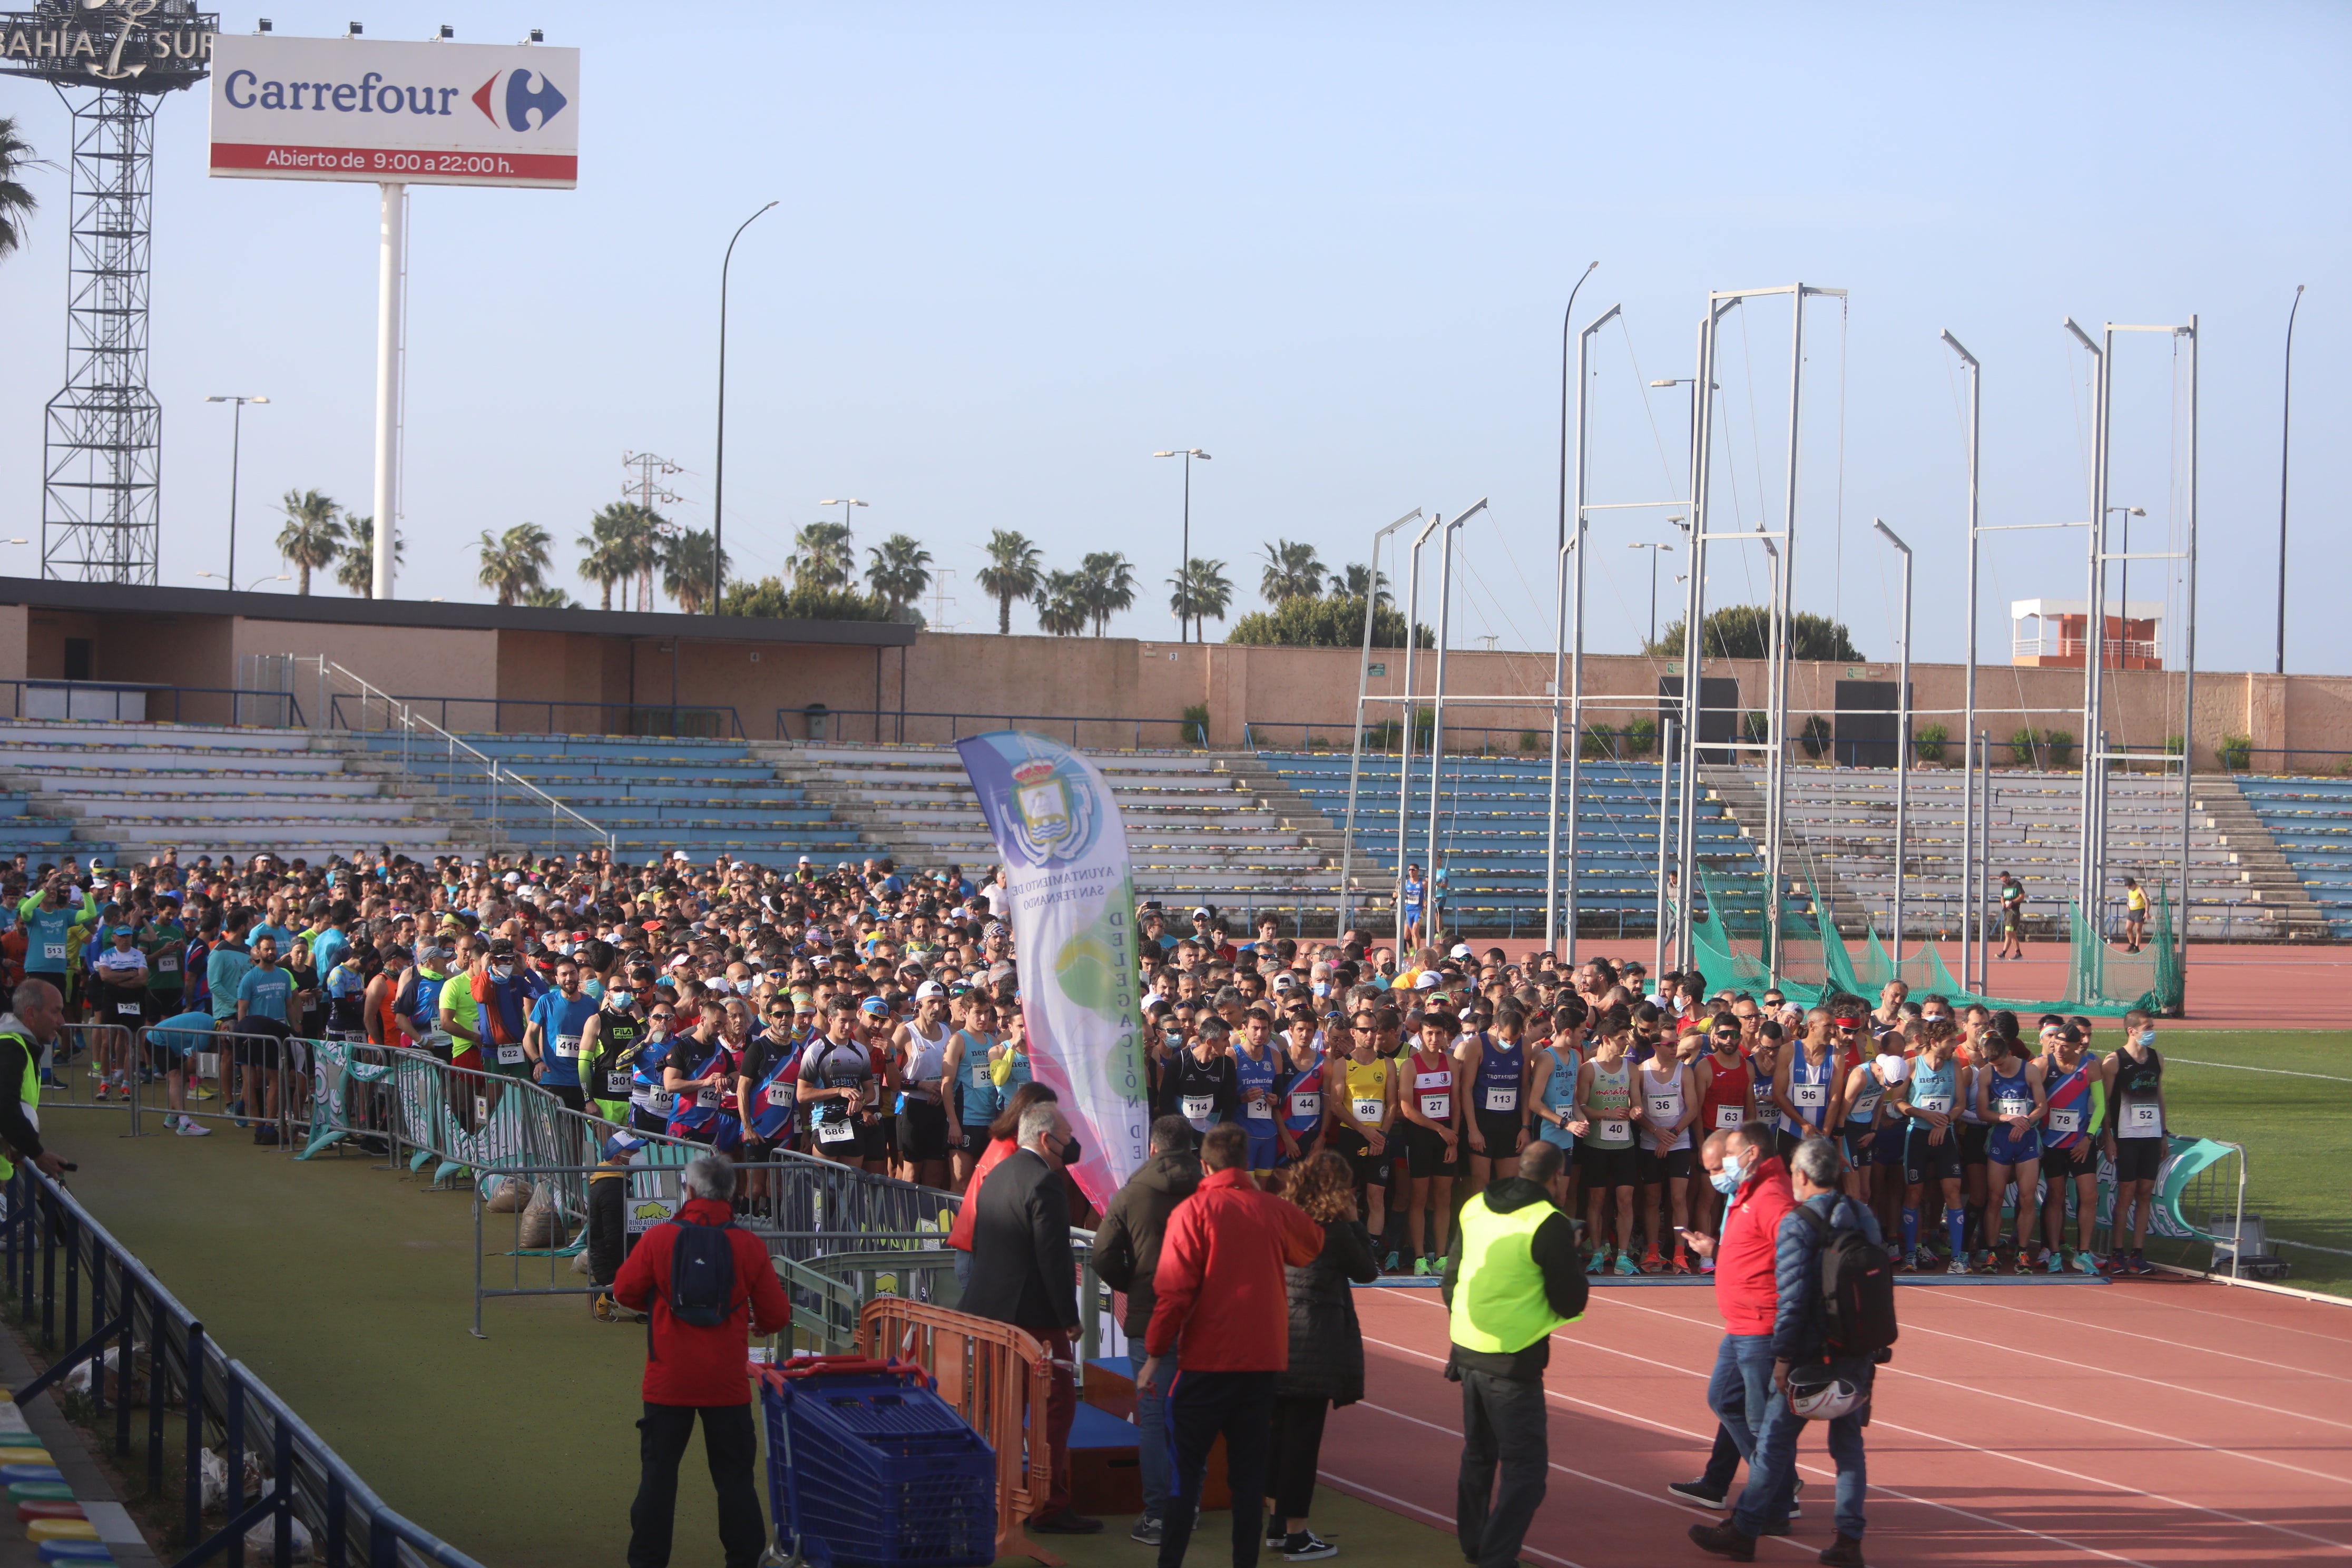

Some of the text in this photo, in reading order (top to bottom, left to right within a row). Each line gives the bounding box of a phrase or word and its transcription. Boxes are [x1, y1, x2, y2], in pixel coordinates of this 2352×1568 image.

[0, 22, 96, 57] AHÍA
[224, 69, 459, 115] Carrefour
[266, 149, 514, 173] Abierto de 9:00 a 22:00 h.
[1012, 1061, 1031, 1069] nerj
[612, 1076, 631, 1085] 801
[1241, 1077, 1272, 1085] Tirabuzón
[1919, 1075, 1945, 1084] nerja
[771, 1089, 792, 1100] 1170
[1595, 1086, 1630, 1096] maratón
[1801, 1091, 1816, 1100] 96
[1863, 1087, 1881, 1095] nerja
[701, 1091, 718, 1101] 422
[1493, 1095, 1511, 1103] 113
[1256, 1102, 1267, 1112] 31
[1299, 1099, 1314, 1108] 44
[1429, 1101, 1442, 1111] 27
[1655, 1101, 1670, 1110] 36
[1929, 1102, 1942, 1111] 51
[1360, 1105, 1375, 1114] 86
[1724, 1112, 1738, 1121] 63
[2056, 1115, 2071, 1125] 78
[2139, 1111, 2153, 1120] 52
[1609, 1124, 1623, 1133] 40
